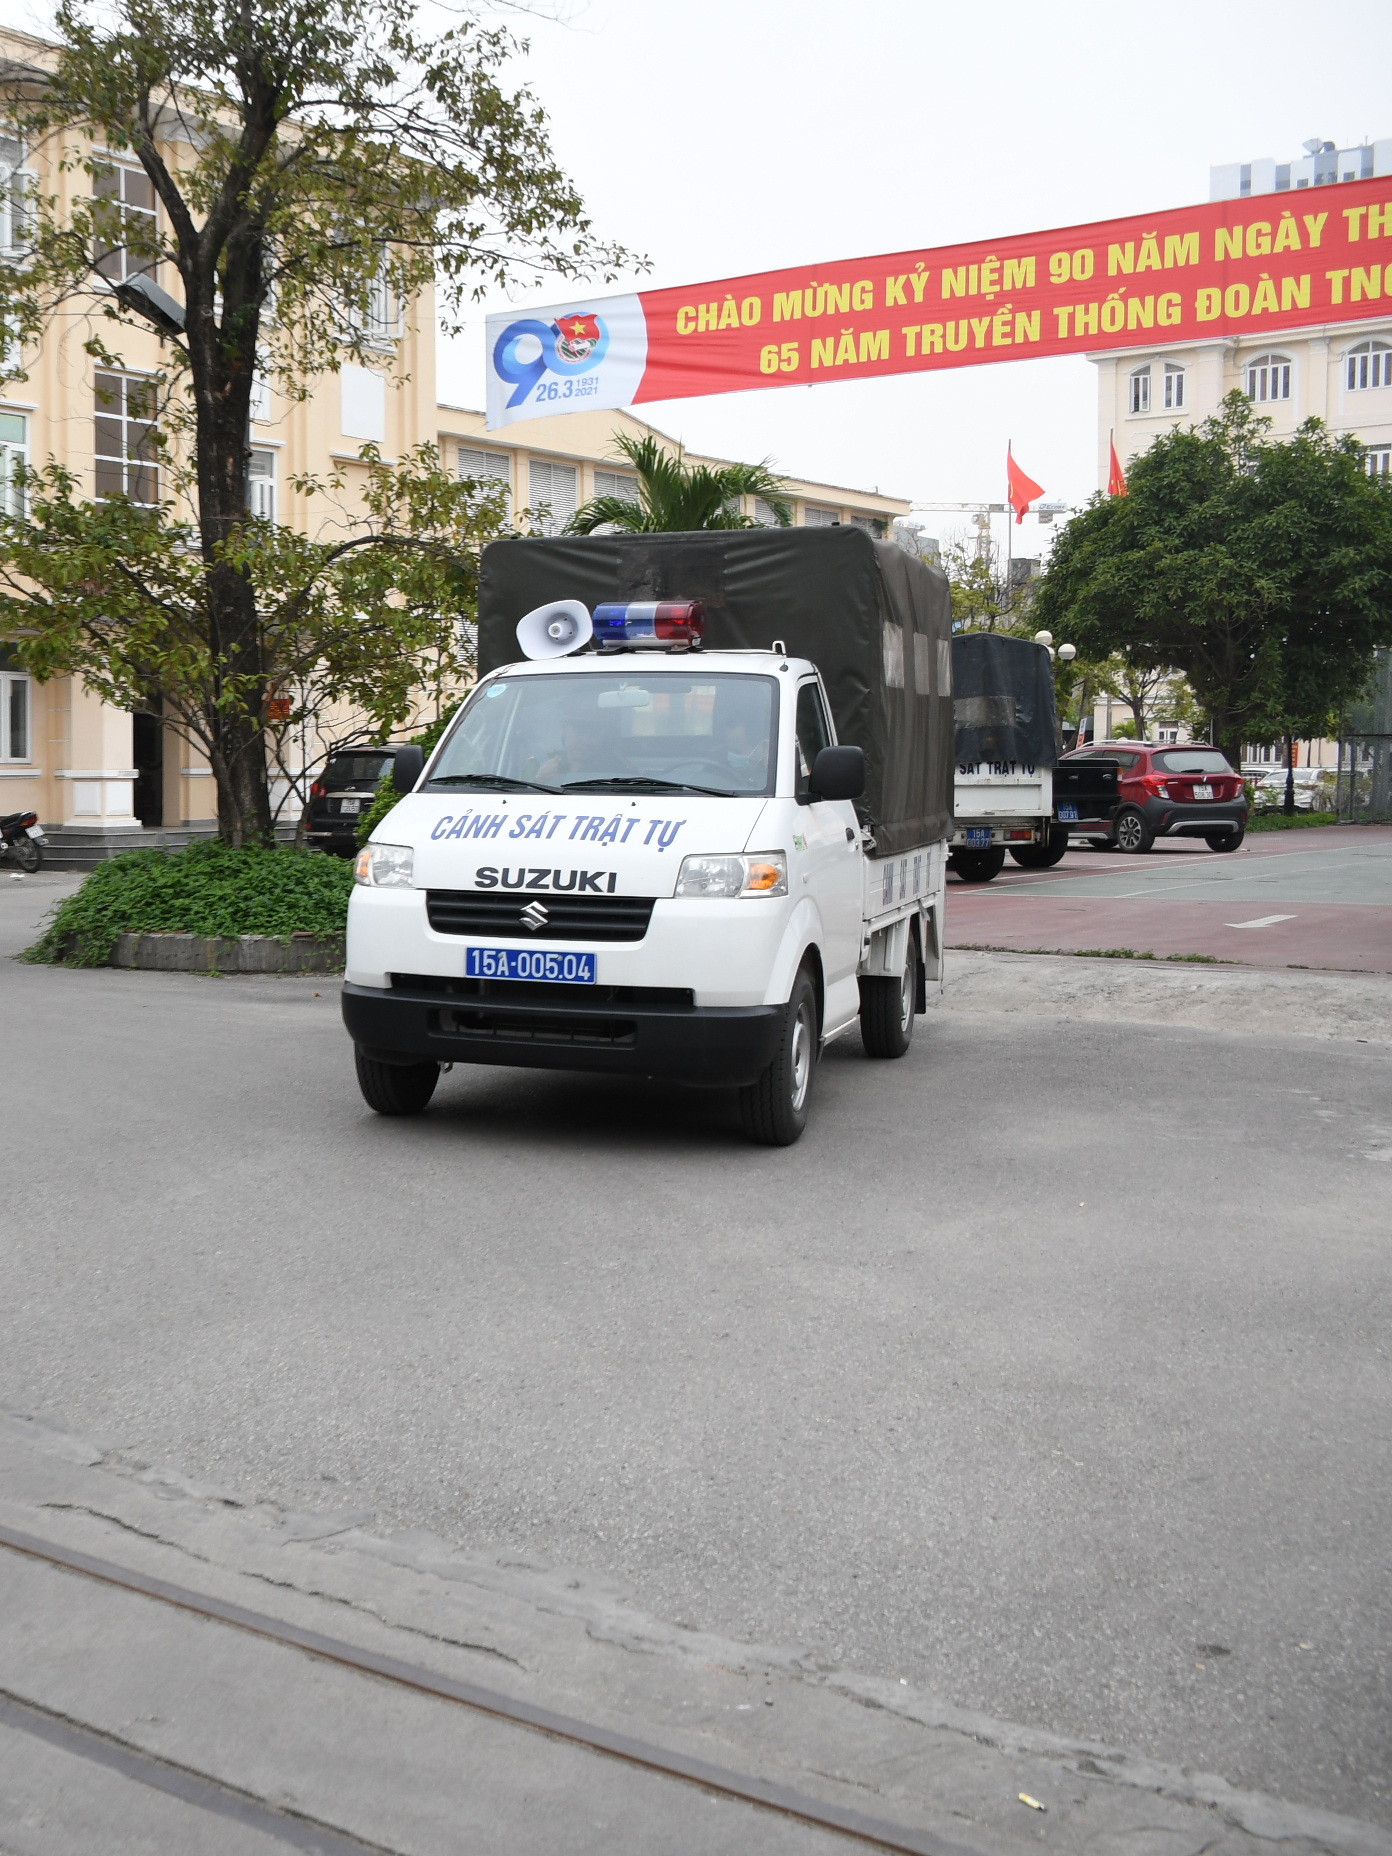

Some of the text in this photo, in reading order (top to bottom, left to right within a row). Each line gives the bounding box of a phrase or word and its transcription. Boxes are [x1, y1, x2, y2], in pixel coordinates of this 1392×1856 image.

[676, 201, 1392, 335] CHÀO MỪNG KỶ NIỆM 90 NĂM NGÀY TH
[759, 341, 799, 375] 65
[810, 328, 891, 369] NĂM
[901, 303, 1041, 357] TRUYỀN
[1053, 287, 1182, 339] THỐNG
[1195, 273, 1311, 323] ĐOÀN
[535, 379, 574, 402] 26.3
[574, 386, 598, 397] 2021
[576, 376, 599, 387] 1931
[430, 808, 686, 853] CẢNH SÁT TRẬT TỰ
[973, 829, 985, 838] 15A
[474, 866, 617, 894] SUZUKI
[472, 949, 591, 980] 15A-005.04
